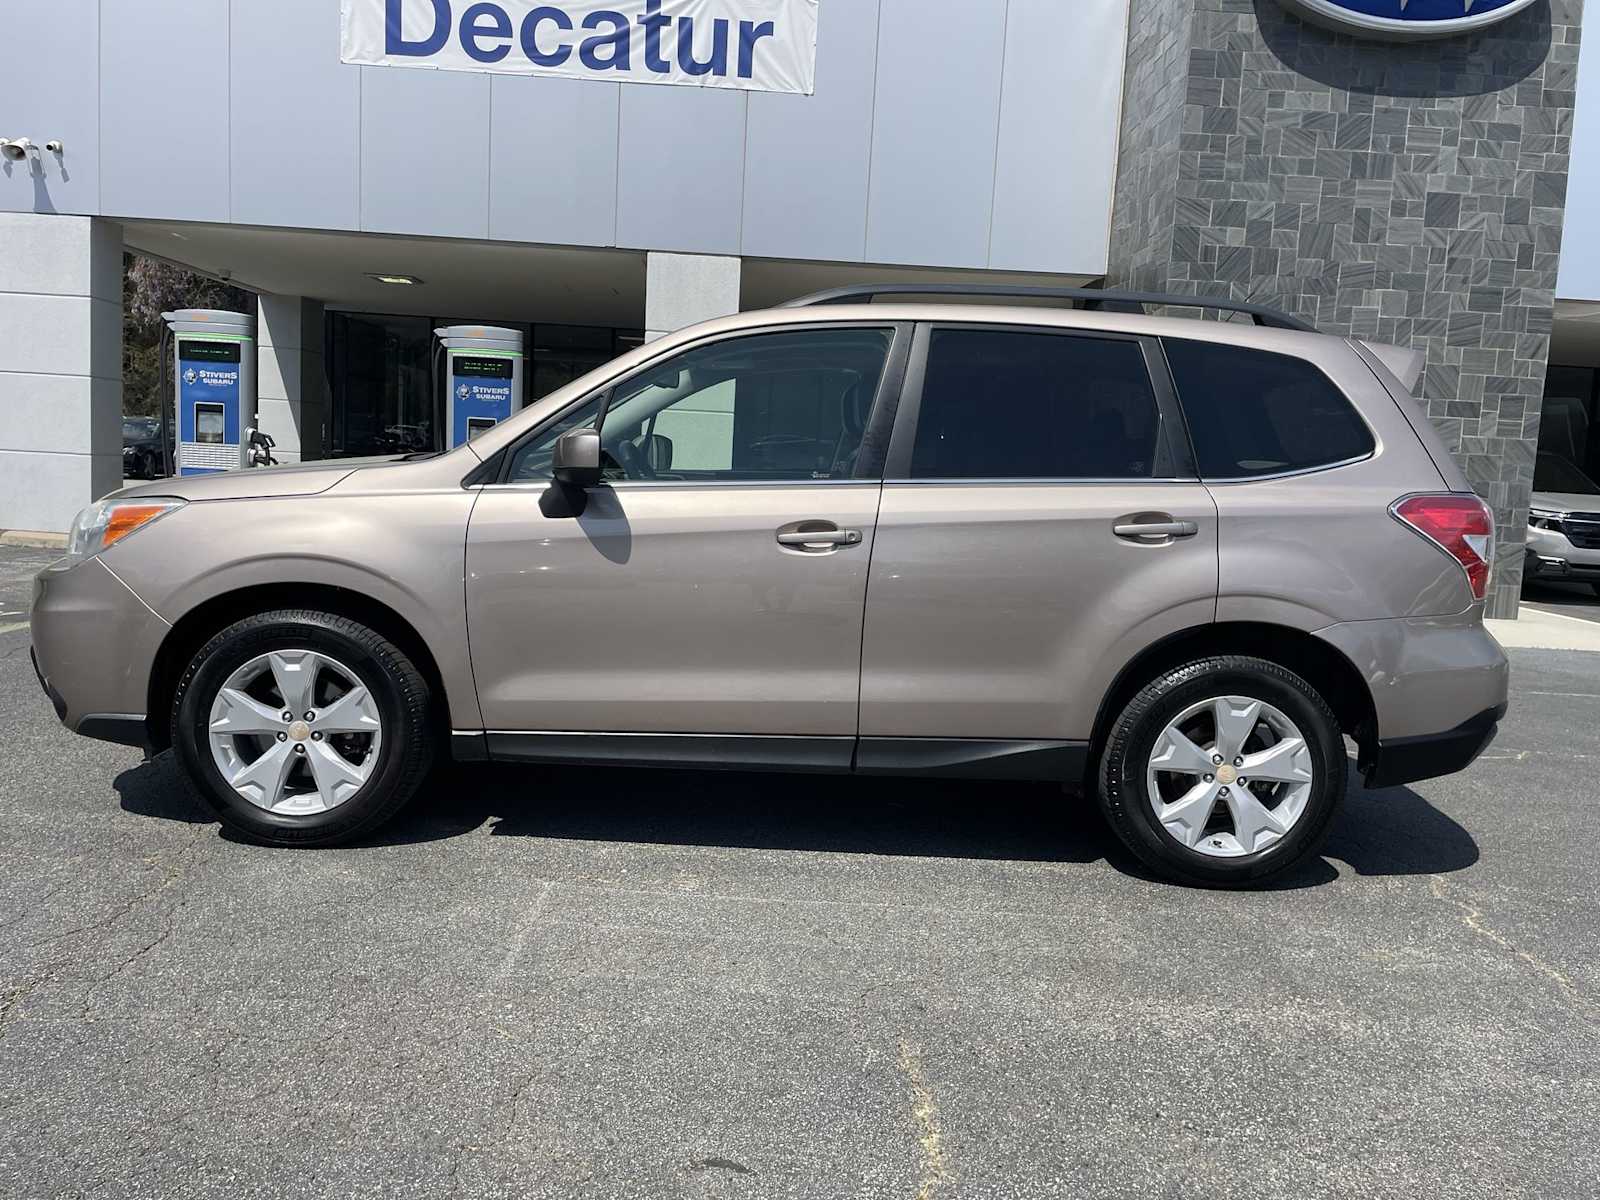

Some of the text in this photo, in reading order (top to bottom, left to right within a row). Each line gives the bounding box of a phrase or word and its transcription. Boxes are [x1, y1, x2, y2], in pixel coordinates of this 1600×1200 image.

[385, 0, 774, 78] Decatur
[199, 370, 238, 379] STIVERS
[472, 386, 510, 395] STIVERS
